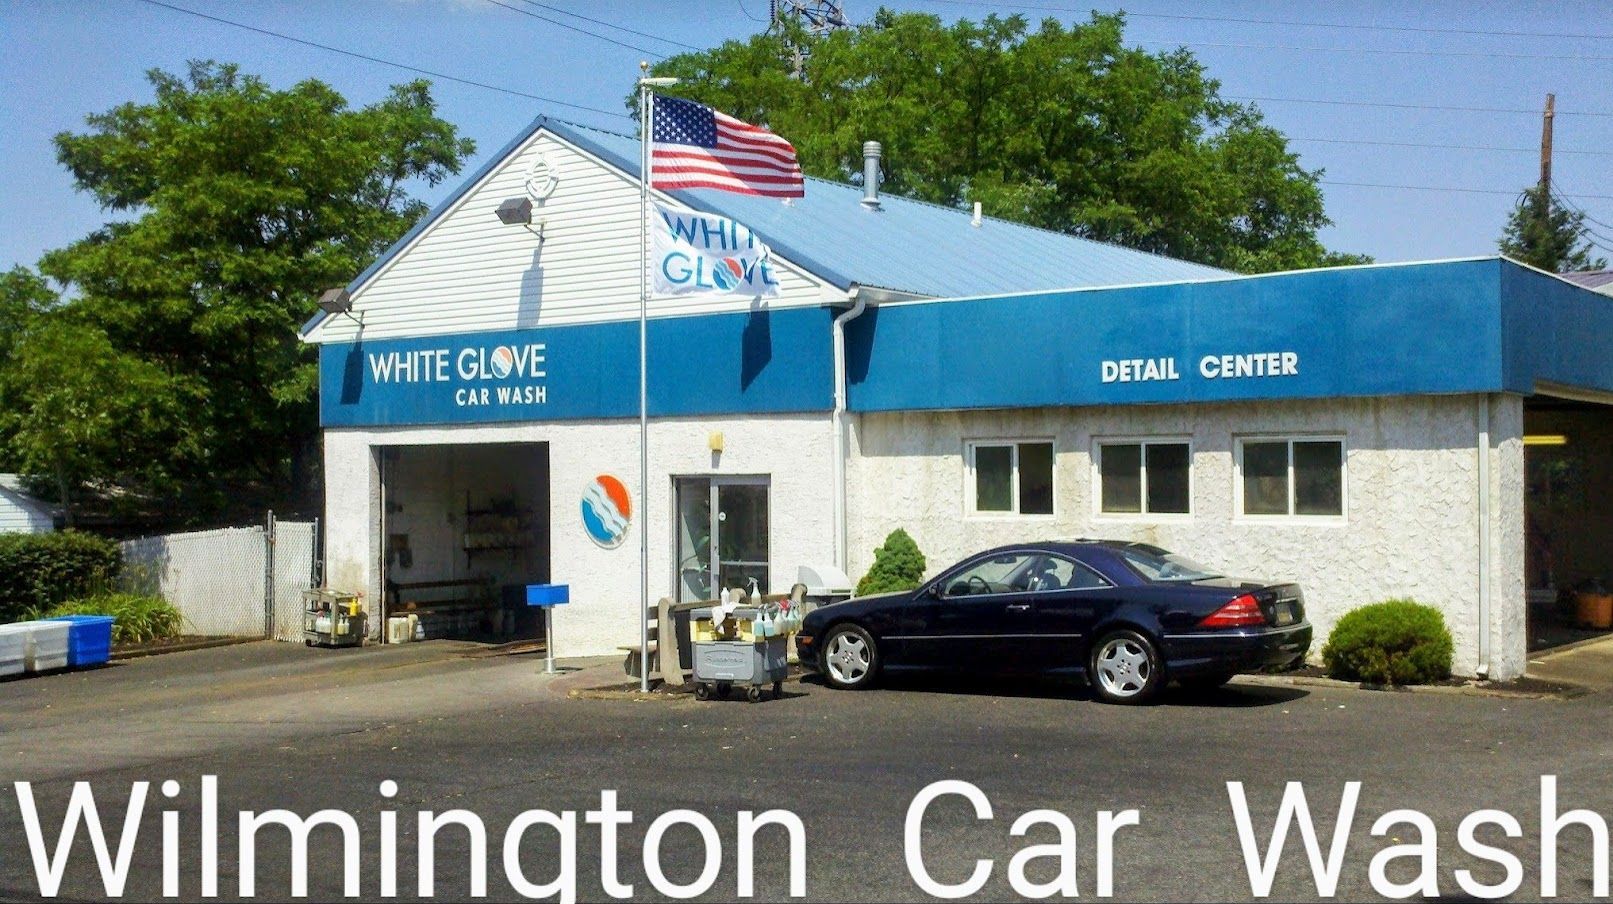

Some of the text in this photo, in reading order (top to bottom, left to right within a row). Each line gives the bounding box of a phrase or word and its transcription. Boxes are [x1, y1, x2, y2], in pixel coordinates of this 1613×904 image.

[662, 211, 755, 250] WHI
[662, 251, 779, 291] GLOVE
[369, 343, 546, 384] WHITE GLOVE
[1101, 352, 1298, 383] DETAIL CENTER
[455, 386, 546, 407] CAR WASH
